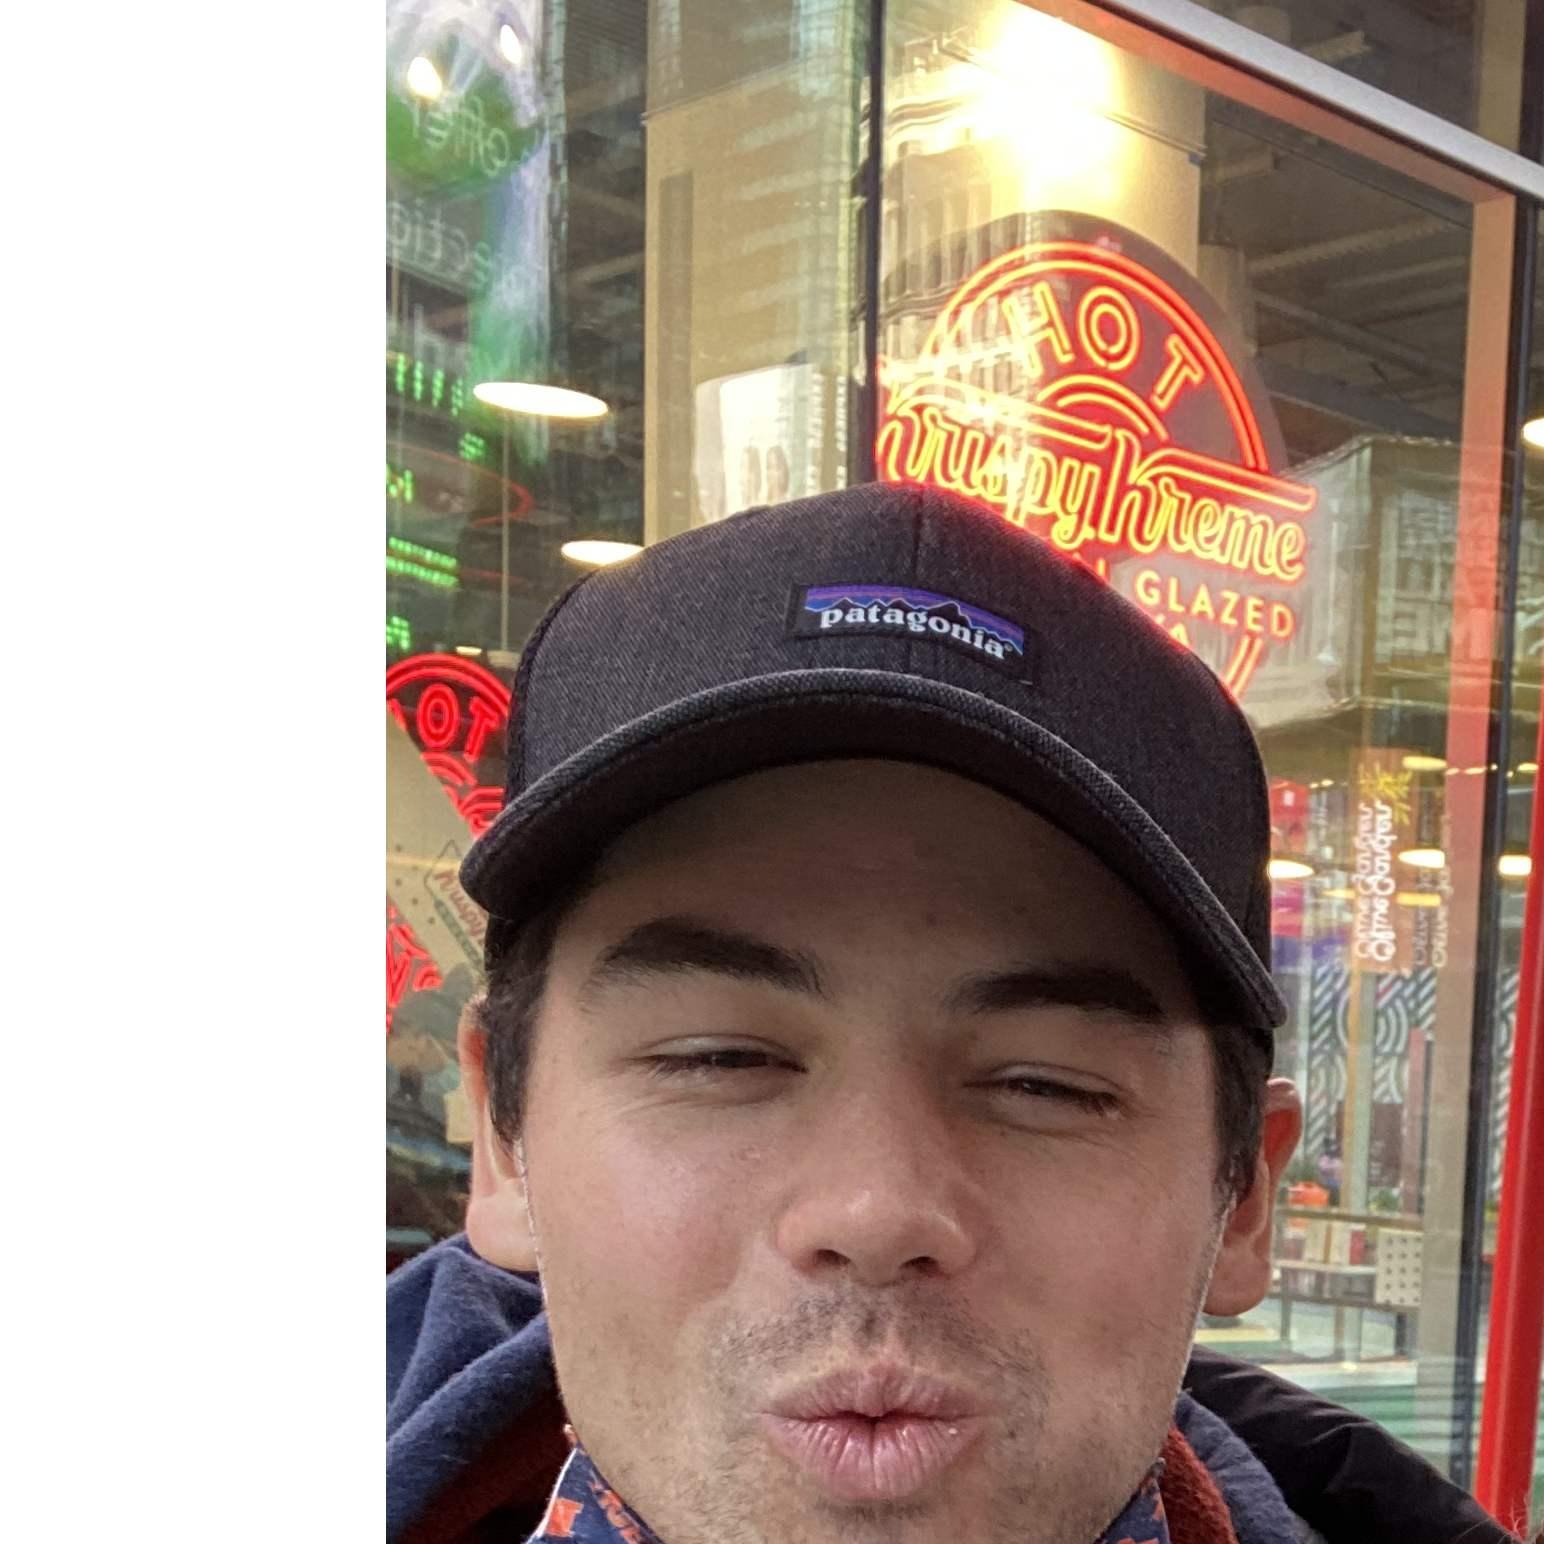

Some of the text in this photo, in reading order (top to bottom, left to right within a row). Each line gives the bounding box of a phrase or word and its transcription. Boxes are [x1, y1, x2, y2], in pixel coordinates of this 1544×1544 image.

[1001, 278, 1203, 413] HOT
[1097, 428, 1318, 582] Kreme
[820, 604, 1006, 660] patagonia
[1135, 567, 1297, 640] GLAZED
